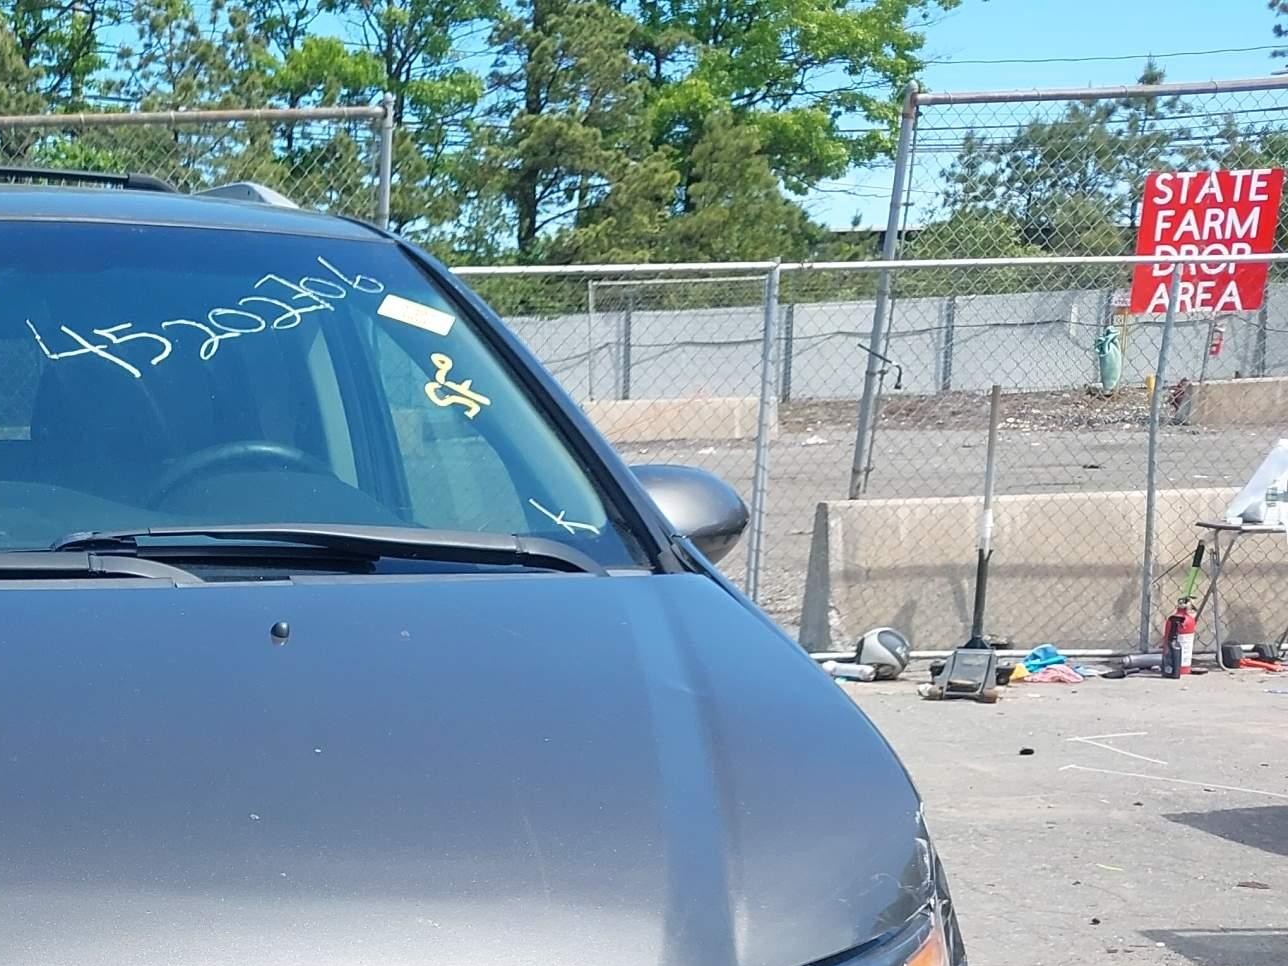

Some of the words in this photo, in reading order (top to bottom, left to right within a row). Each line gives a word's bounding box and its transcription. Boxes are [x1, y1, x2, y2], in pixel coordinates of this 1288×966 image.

[1152, 169, 1272, 205] STATE
[1154, 207, 1261, 242] FARM
[1152, 242, 1252, 277] DROP
[1145, 280, 1243, 314] AREA
[26, 256, 385, 378] 45202706
